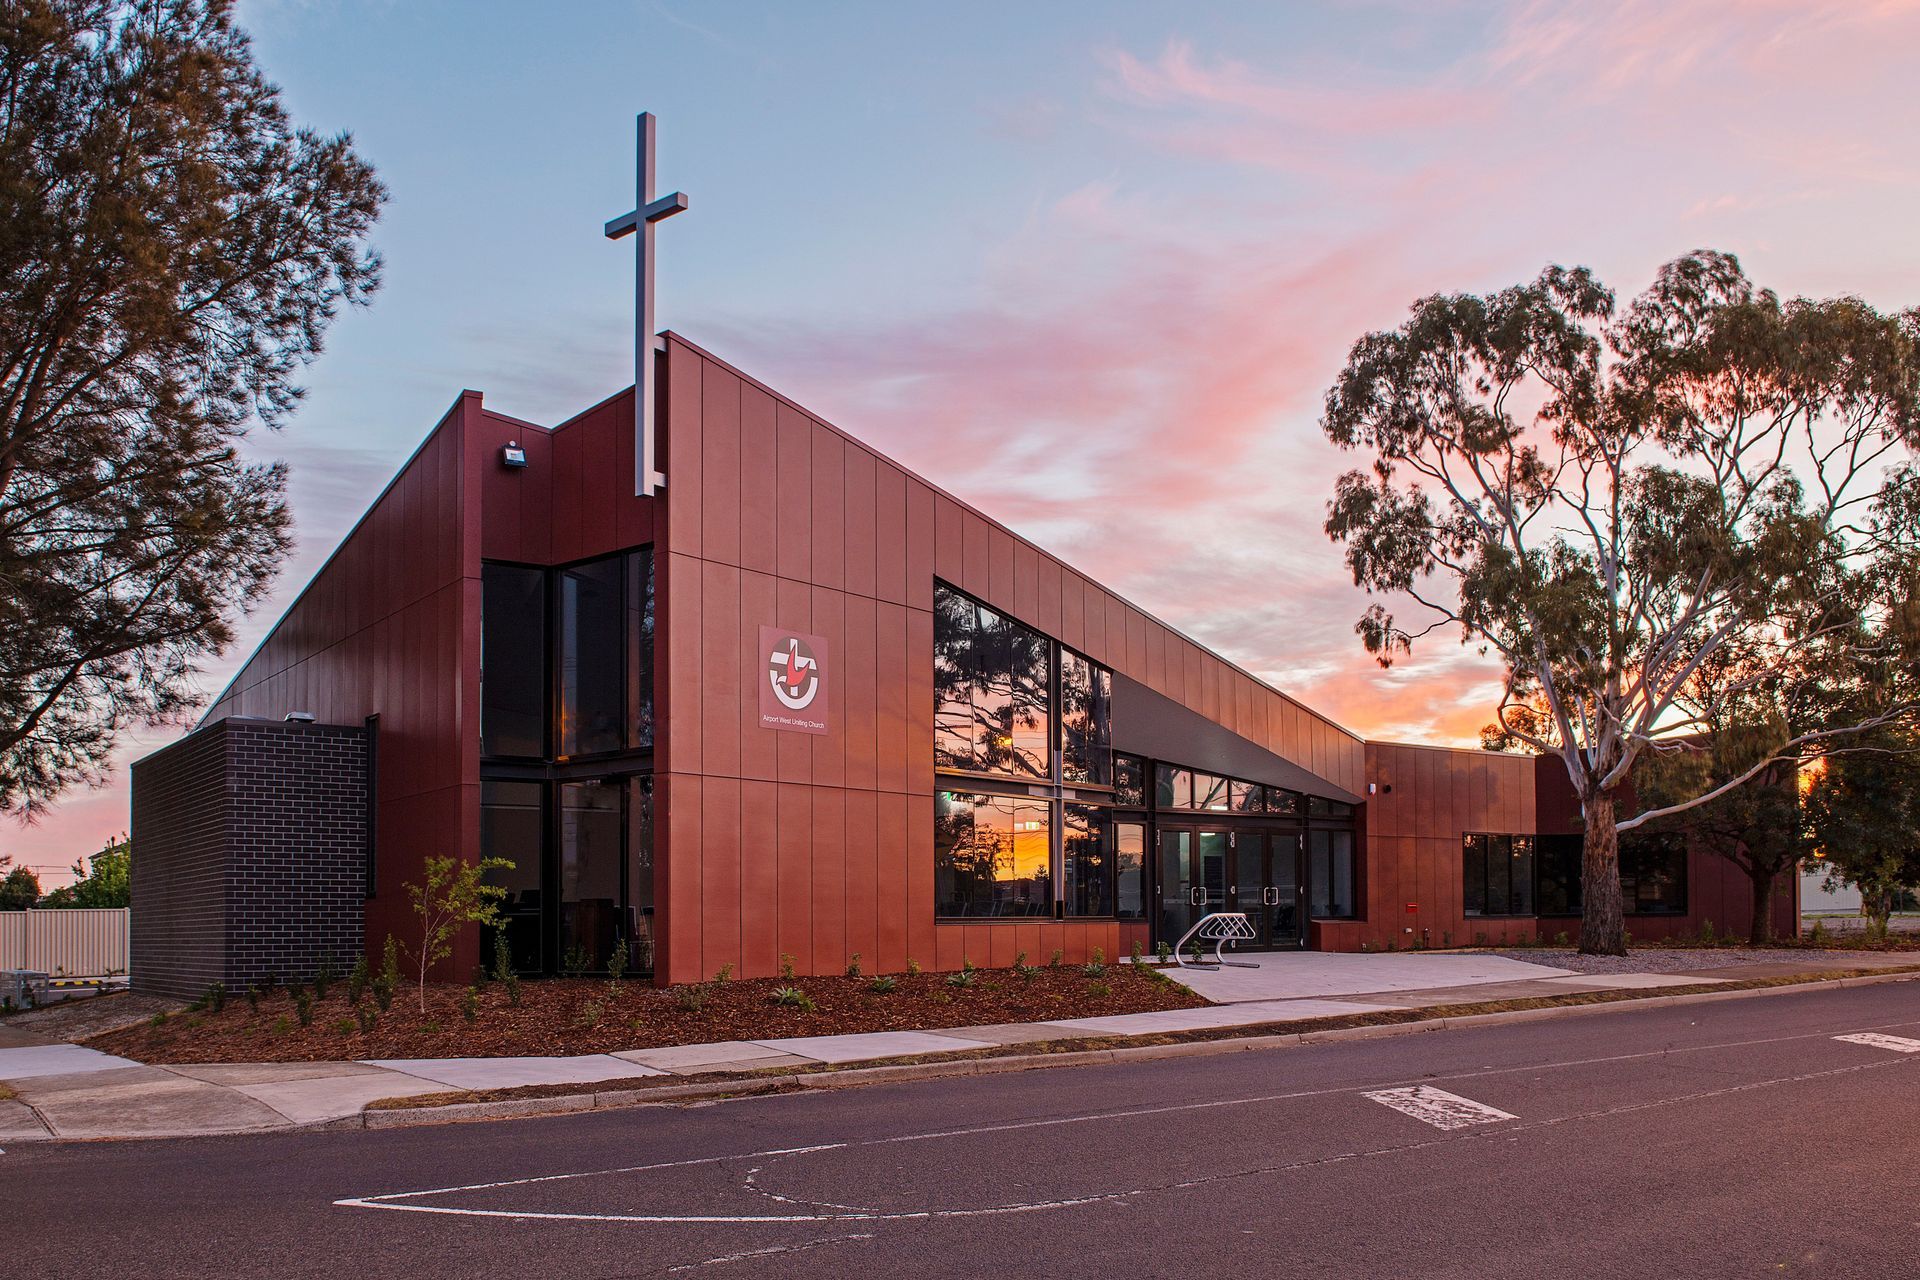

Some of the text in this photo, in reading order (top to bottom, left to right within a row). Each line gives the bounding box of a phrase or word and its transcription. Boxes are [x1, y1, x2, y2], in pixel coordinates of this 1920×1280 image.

[763, 714, 825, 729] Airport West Uniting Church
